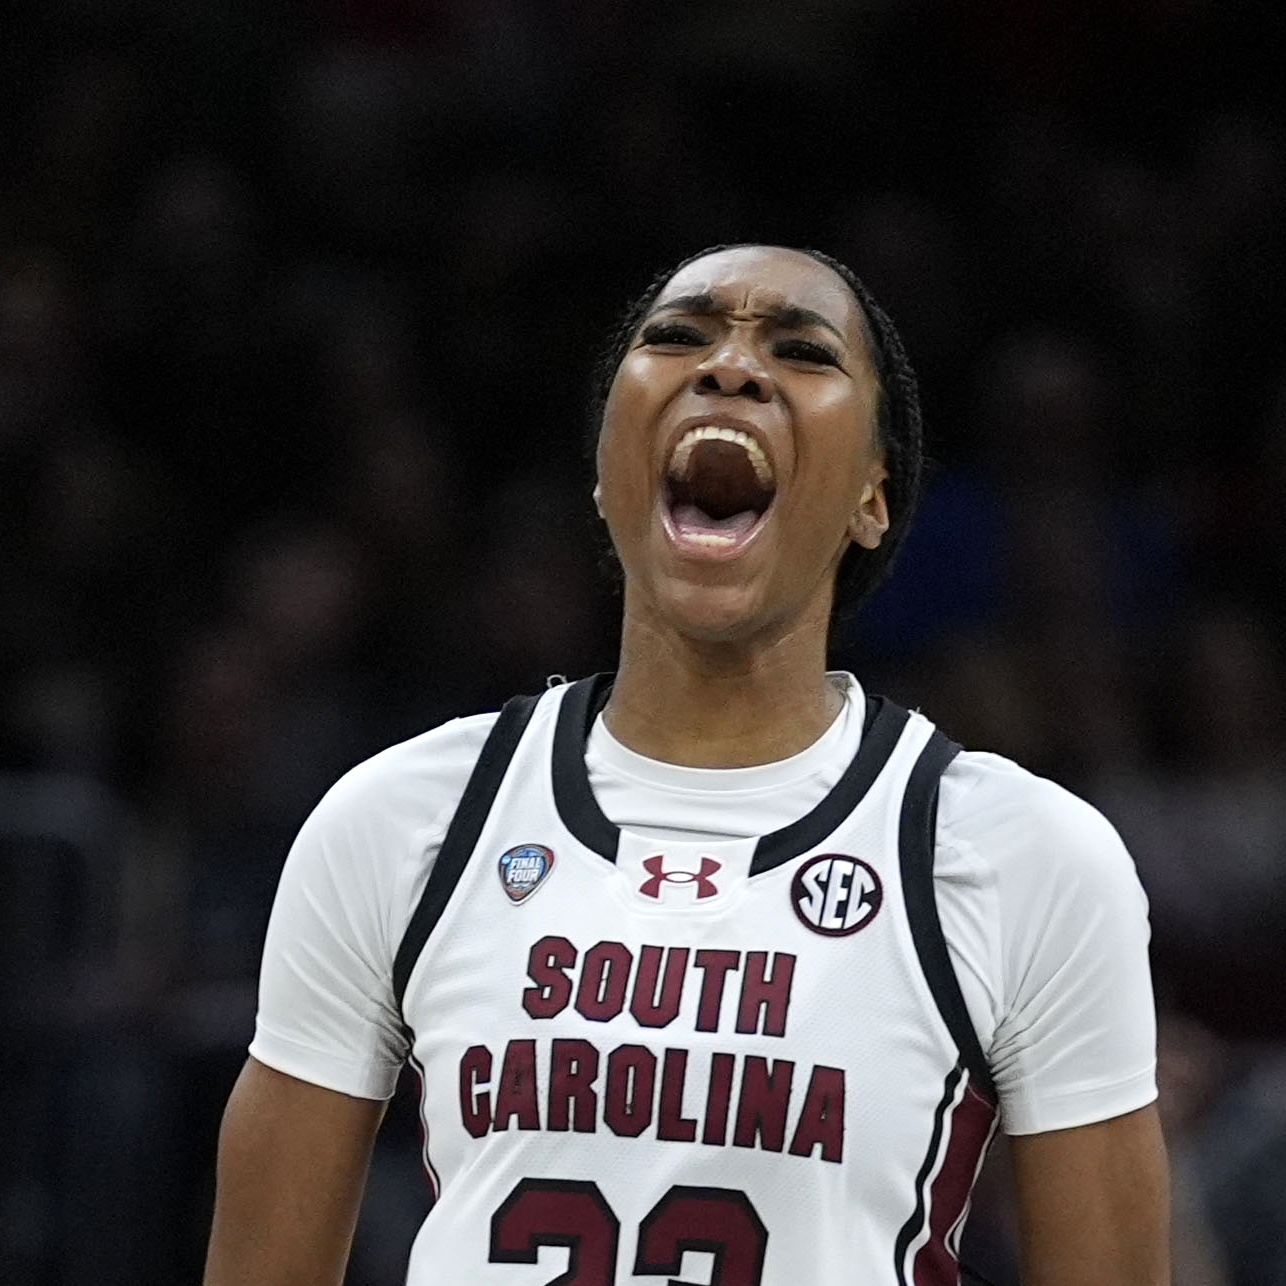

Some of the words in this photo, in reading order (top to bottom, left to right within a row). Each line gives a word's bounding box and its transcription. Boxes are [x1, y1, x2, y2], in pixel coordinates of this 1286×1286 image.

[797, 857, 876, 930] SEC
[521, 935, 797, 1038] SOUTH
[458, 1037, 846, 1165] CAROLINA
